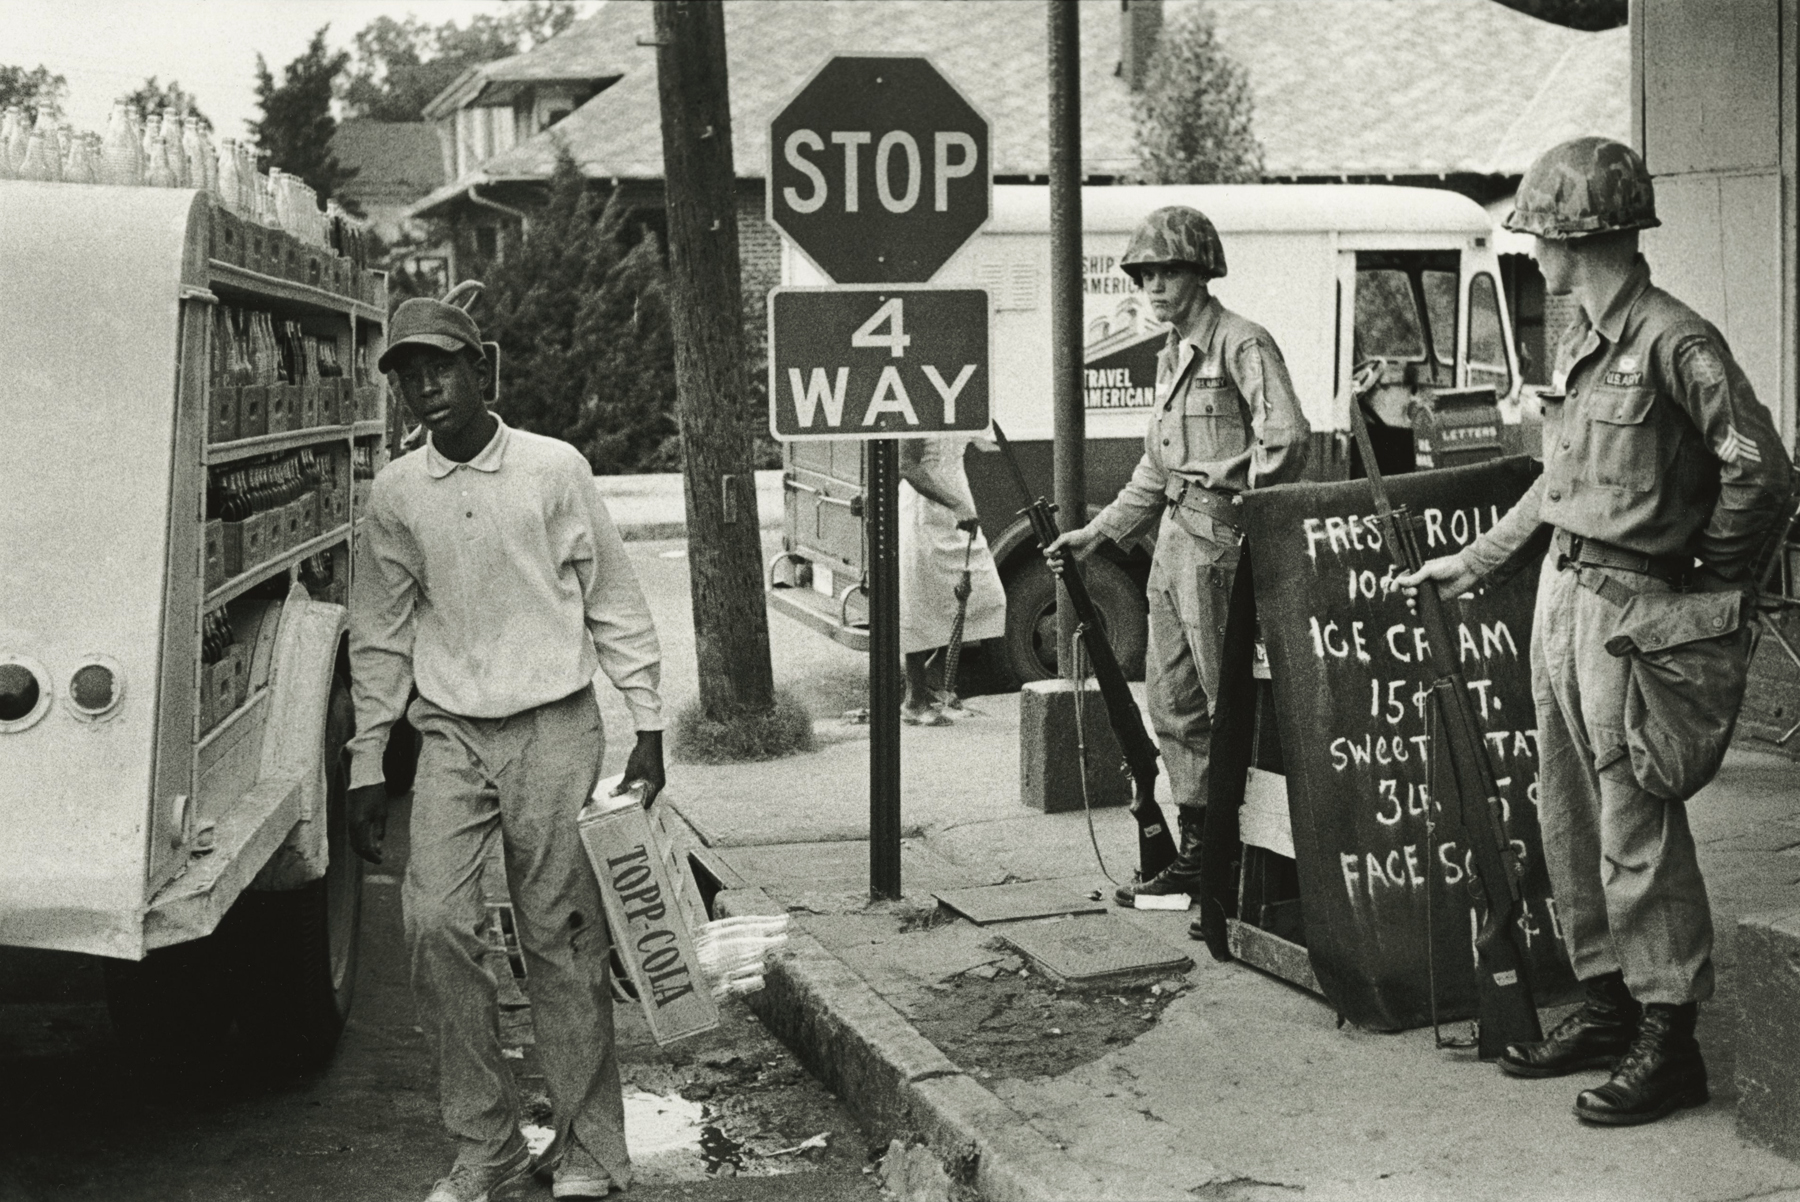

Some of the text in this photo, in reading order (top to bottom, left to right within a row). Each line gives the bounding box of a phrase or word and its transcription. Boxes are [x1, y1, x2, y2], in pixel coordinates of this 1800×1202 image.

[783, 128, 978, 214] STOP
[1083, 256, 1115, 274] SHIP
[1083, 277, 1141, 294] AMERIC
[851, 297, 911, 358] 4
[788, 364, 978, 428] WAY
[1084, 367, 1132, 388] TRAVEL
[1441, 426, 1497, 441] LETTERS
[1304, 514, 1384, 558] FRES
[1309, 616, 1518, 663] ICE CRAM
[1371, 679, 1428, 724] 15¢
[1376, 779, 1402, 825] 3
[1340, 844, 1425, 902] FACE
[606, 844, 694, 1009] TOPP-COLA
